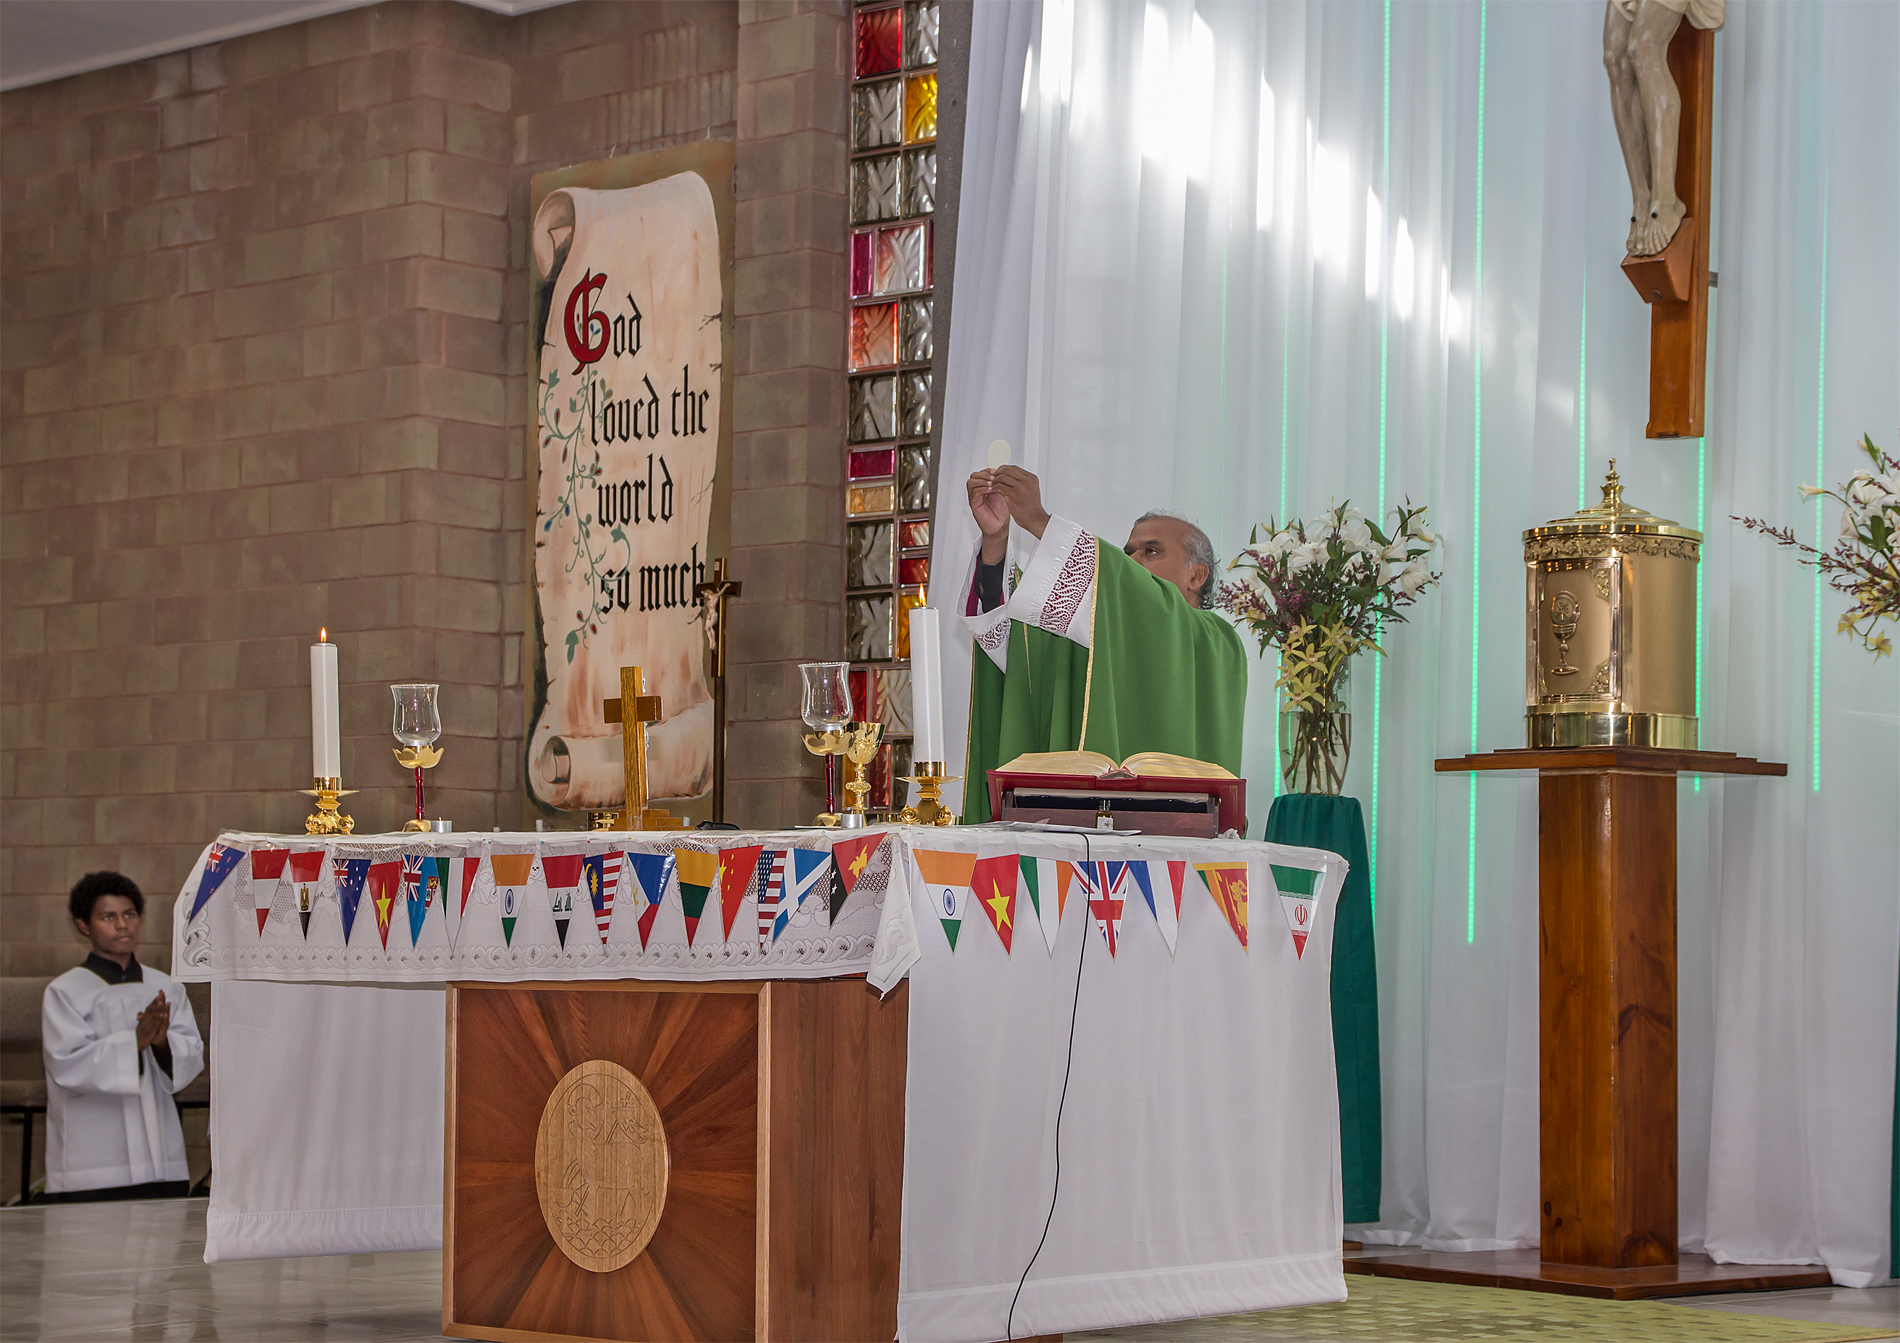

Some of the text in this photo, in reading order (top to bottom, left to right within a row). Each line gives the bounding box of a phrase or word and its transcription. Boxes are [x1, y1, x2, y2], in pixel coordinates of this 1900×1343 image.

[564, 267, 643, 376] God
[590, 363, 710, 447] loved the
[597, 453, 674, 528] world
[600, 541, 706, 614] so much
